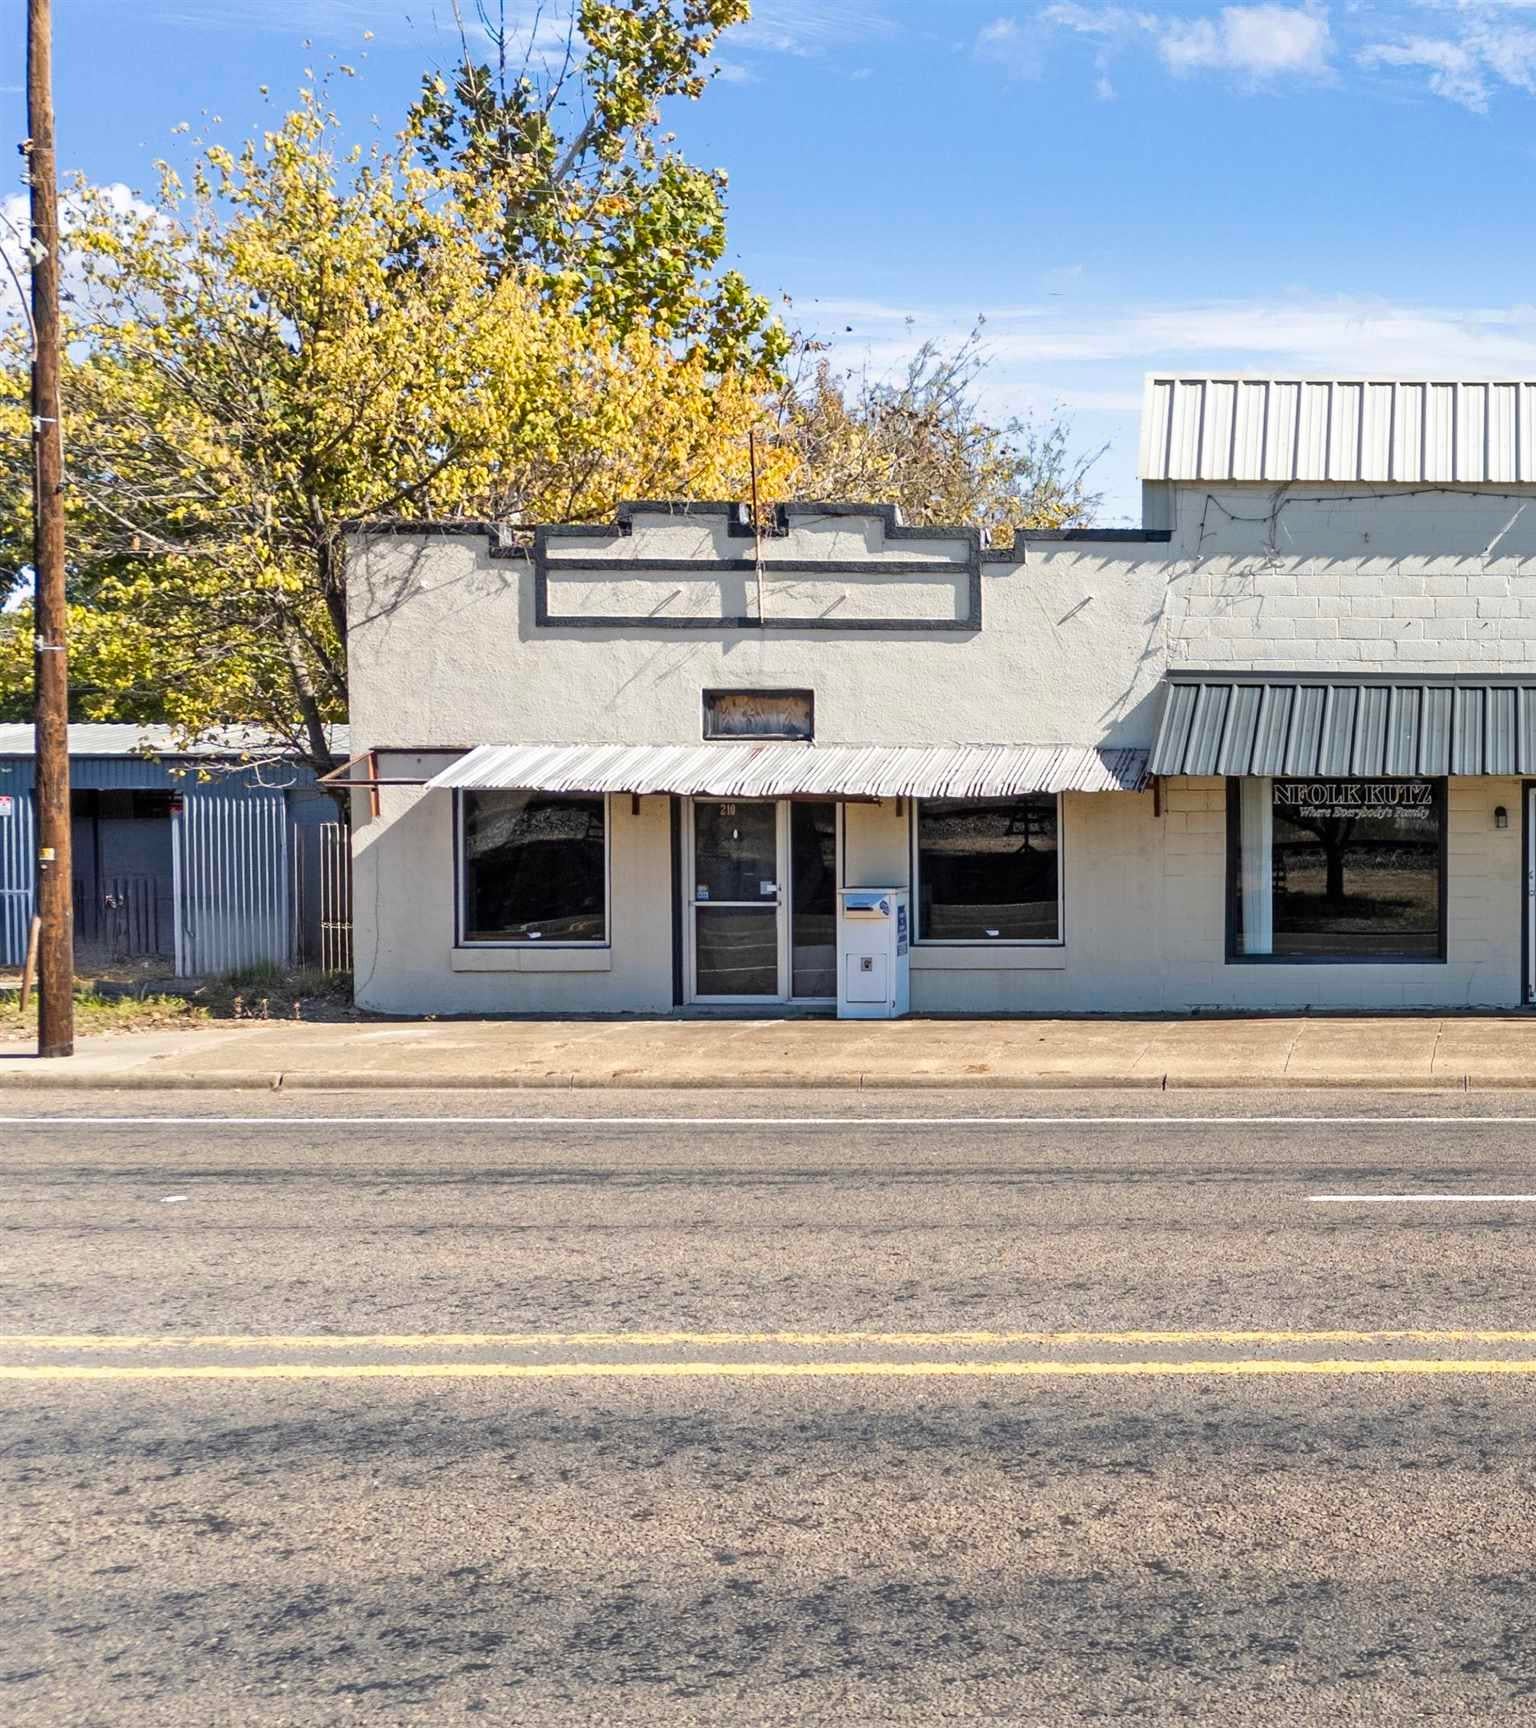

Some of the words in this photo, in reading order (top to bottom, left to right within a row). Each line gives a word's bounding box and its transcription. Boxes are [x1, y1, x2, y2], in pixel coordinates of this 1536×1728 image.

[1364, 784, 1433, 805] KUTZ
[719, 803, 736, 816] 210
[1299, 806, 1332, 818] Where
[1332, 806, 1393, 819] Everybody's
[1393, 806, 1430, 819] Family
